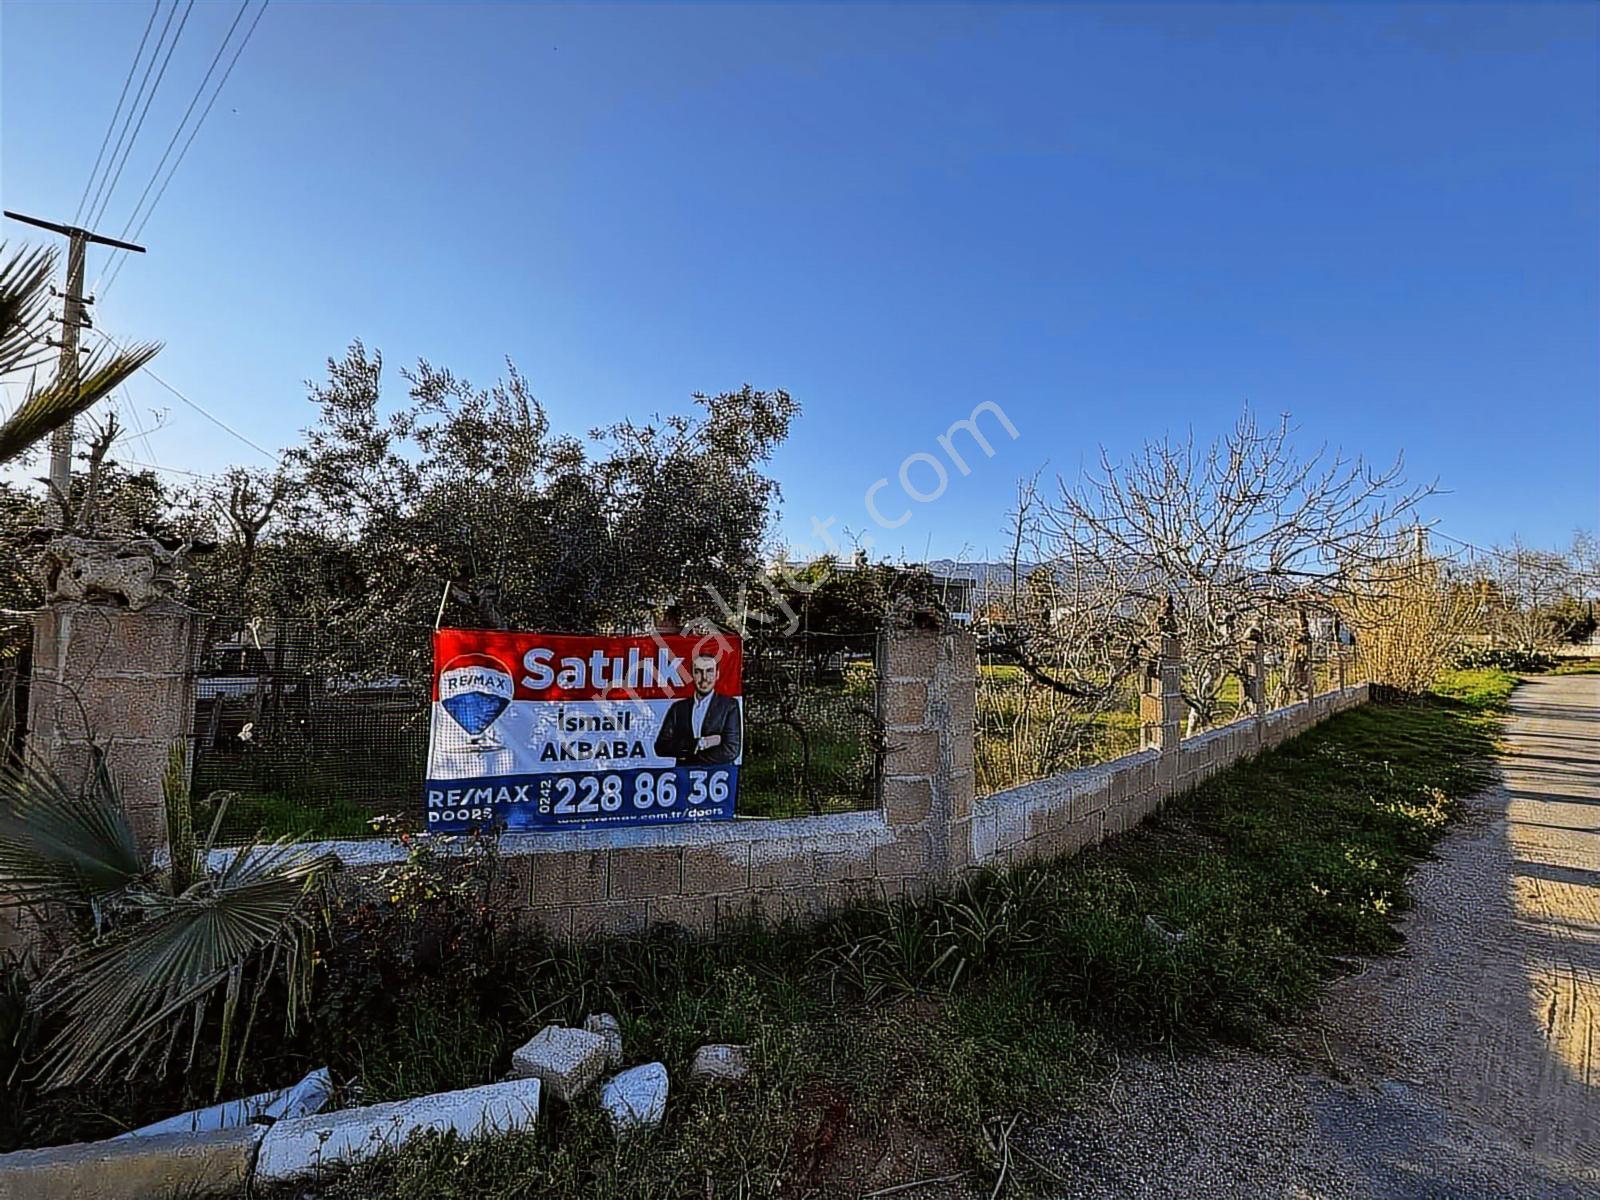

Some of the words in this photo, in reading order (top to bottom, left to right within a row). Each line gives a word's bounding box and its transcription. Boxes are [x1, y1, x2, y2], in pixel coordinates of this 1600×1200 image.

[449, 673, 505, 690] RE/MAX
[521, 647, 685, 690] Satılık
[540, 740, 646, 761] AKBABA
[428, 784, 530, 808] RE/MAX
[539, 779, 552, 813] 0242
[553, 774, 622, 814] 228
[633, 772, 677, 809] 86
[687, 770, 729, 804] 36
